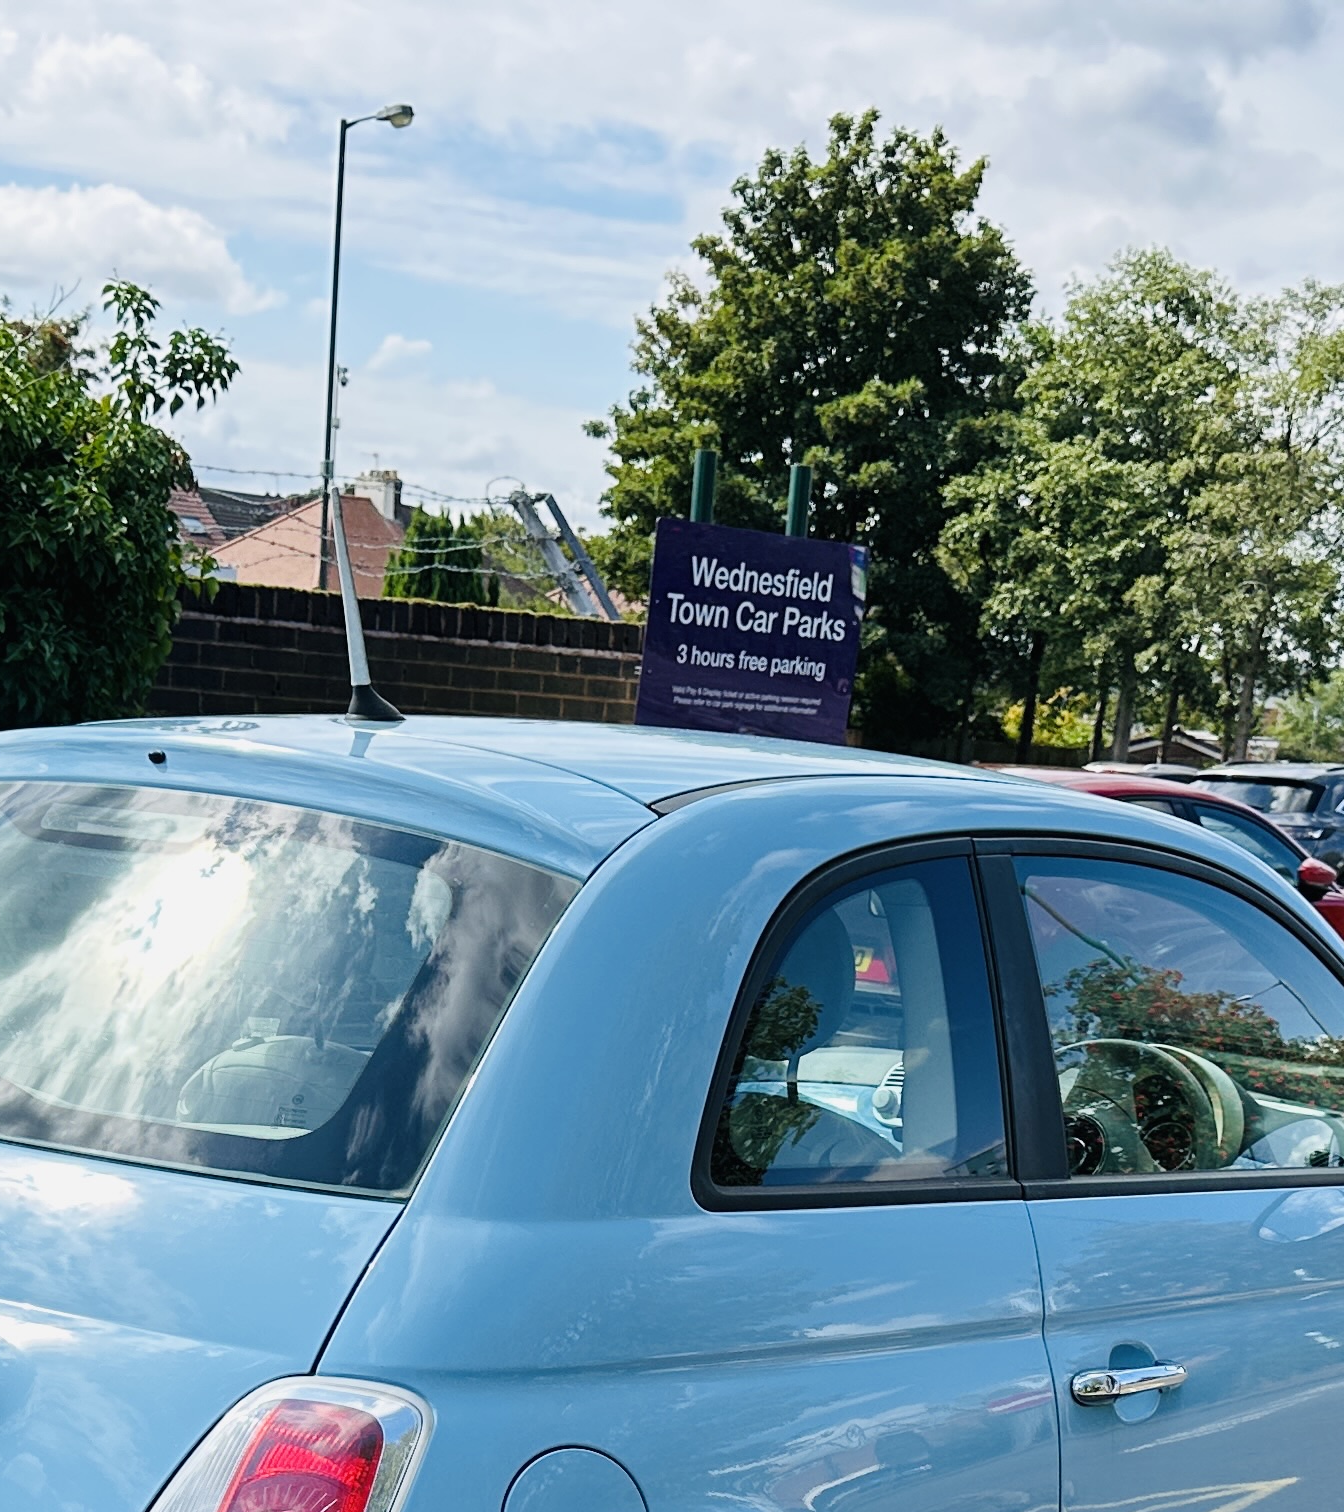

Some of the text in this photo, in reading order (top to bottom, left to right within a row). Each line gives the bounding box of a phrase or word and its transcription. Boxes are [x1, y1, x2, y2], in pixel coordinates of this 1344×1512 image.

[692, 556, 834, 603] Wednesfield
[667, 592, 846, 642] Town Car Parks
[676, 644, 826, 682] 3 hours free parking
